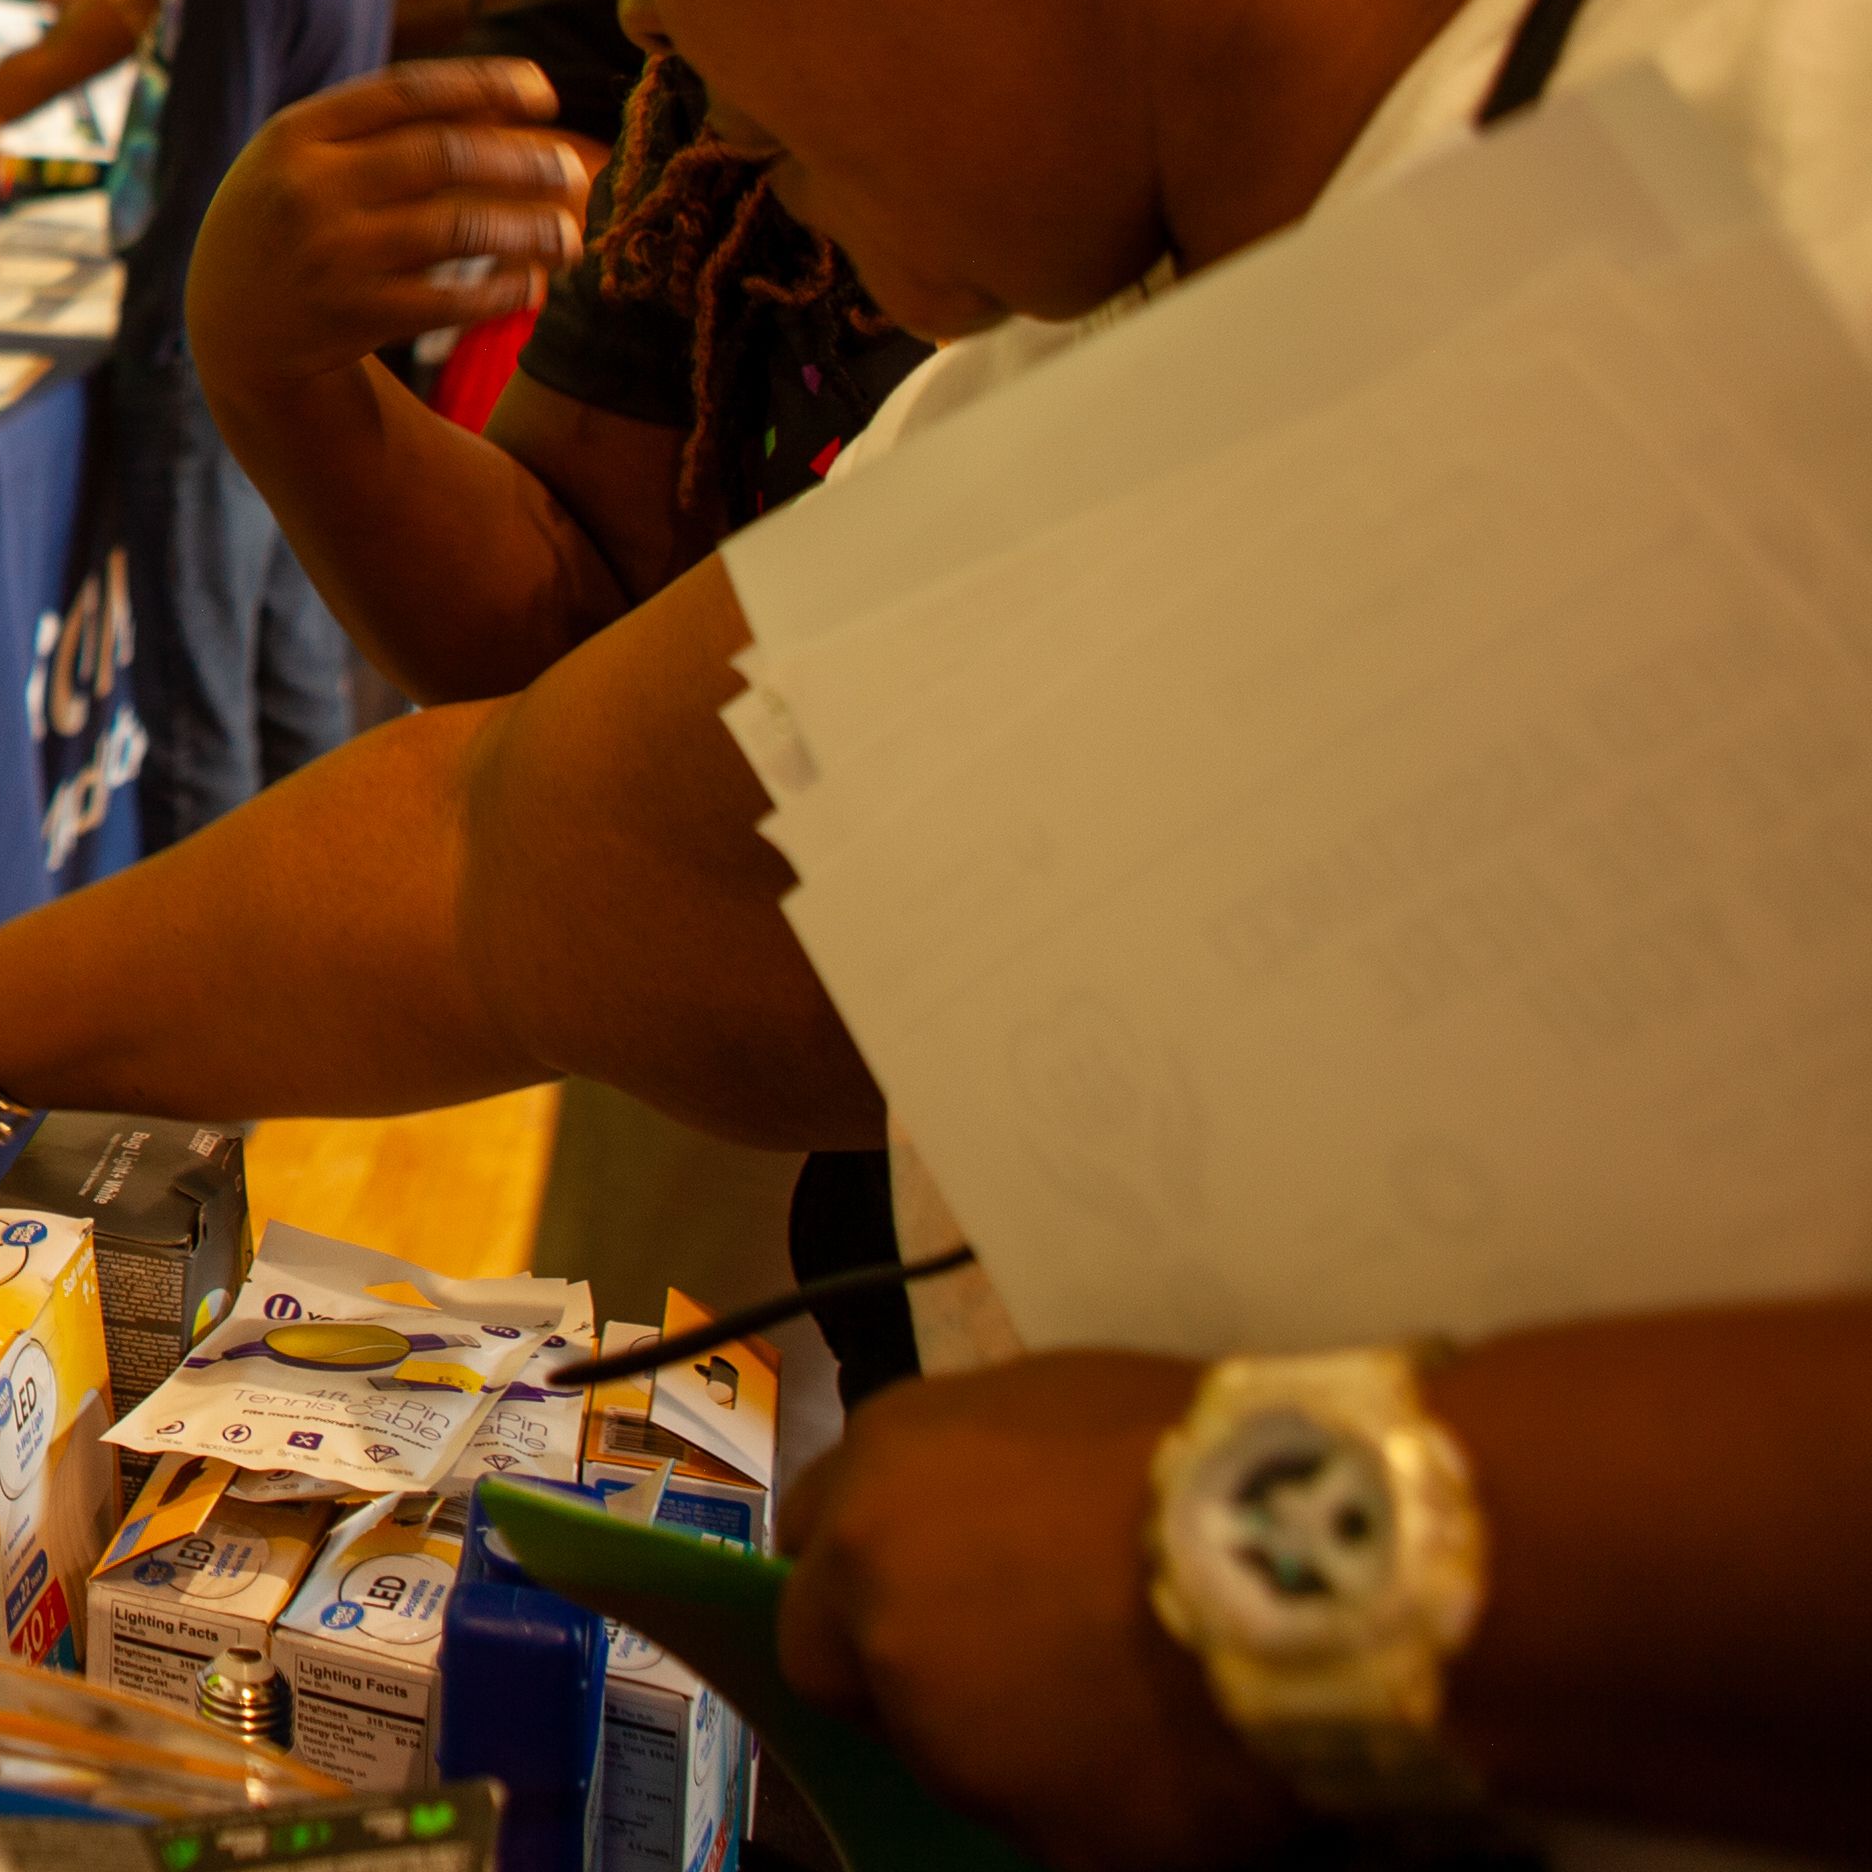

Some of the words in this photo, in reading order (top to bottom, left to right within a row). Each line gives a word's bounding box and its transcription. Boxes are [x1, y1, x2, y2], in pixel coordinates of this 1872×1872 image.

[121, 1131, 151, 1150] Bug
[93, 1174, 124, 1205] White
[11, 1376, 38, 1433] LED
[232, 1388, 335, 1413] Tennis
[344, 1403, 443, 1442] Cable
[305, 1389, 353, 1404] 4ft.
[363, 1395, 451, 1429] 8-Pin
[362, 1425, 389, 1435] and
[475, 1422, 546, 1450] able
[484, 1410, 549, 1437] -Pin
[173, 1538, 216, 1572] LED
[19, 1581, 32, 1601] 22
[363, 1574, 407, 1612] LED
[398, 1577, 431, 1619] Decorative
[114, 1606, 175, 1636] Lighting
[178, 1622, 219, 1643] Facts
[113, 1643, 163, 1665] Brightness
[113, 1656, 158, 1677] Estimated
[158, 1669, 189, 1685] Yearly
[113, 1666, 145, 1686] Energy
[146, 1674, 168, 1688] Cost
[299, 1660, 362, 1690] Lighting
[366, 1679, 409, 1699] Facts
[118, 1678, 143, 1692] Based
[298, 1699, 349, 1720] Brightness
[298, 1712, 345, 1732] Estimated
[346, 1724, 376, 1742] Yearly
[298, 1722, 330, 1740] Energy
[332, 1732, 355, 1746] Cost
[303, 1735, 329, 1747] Based
